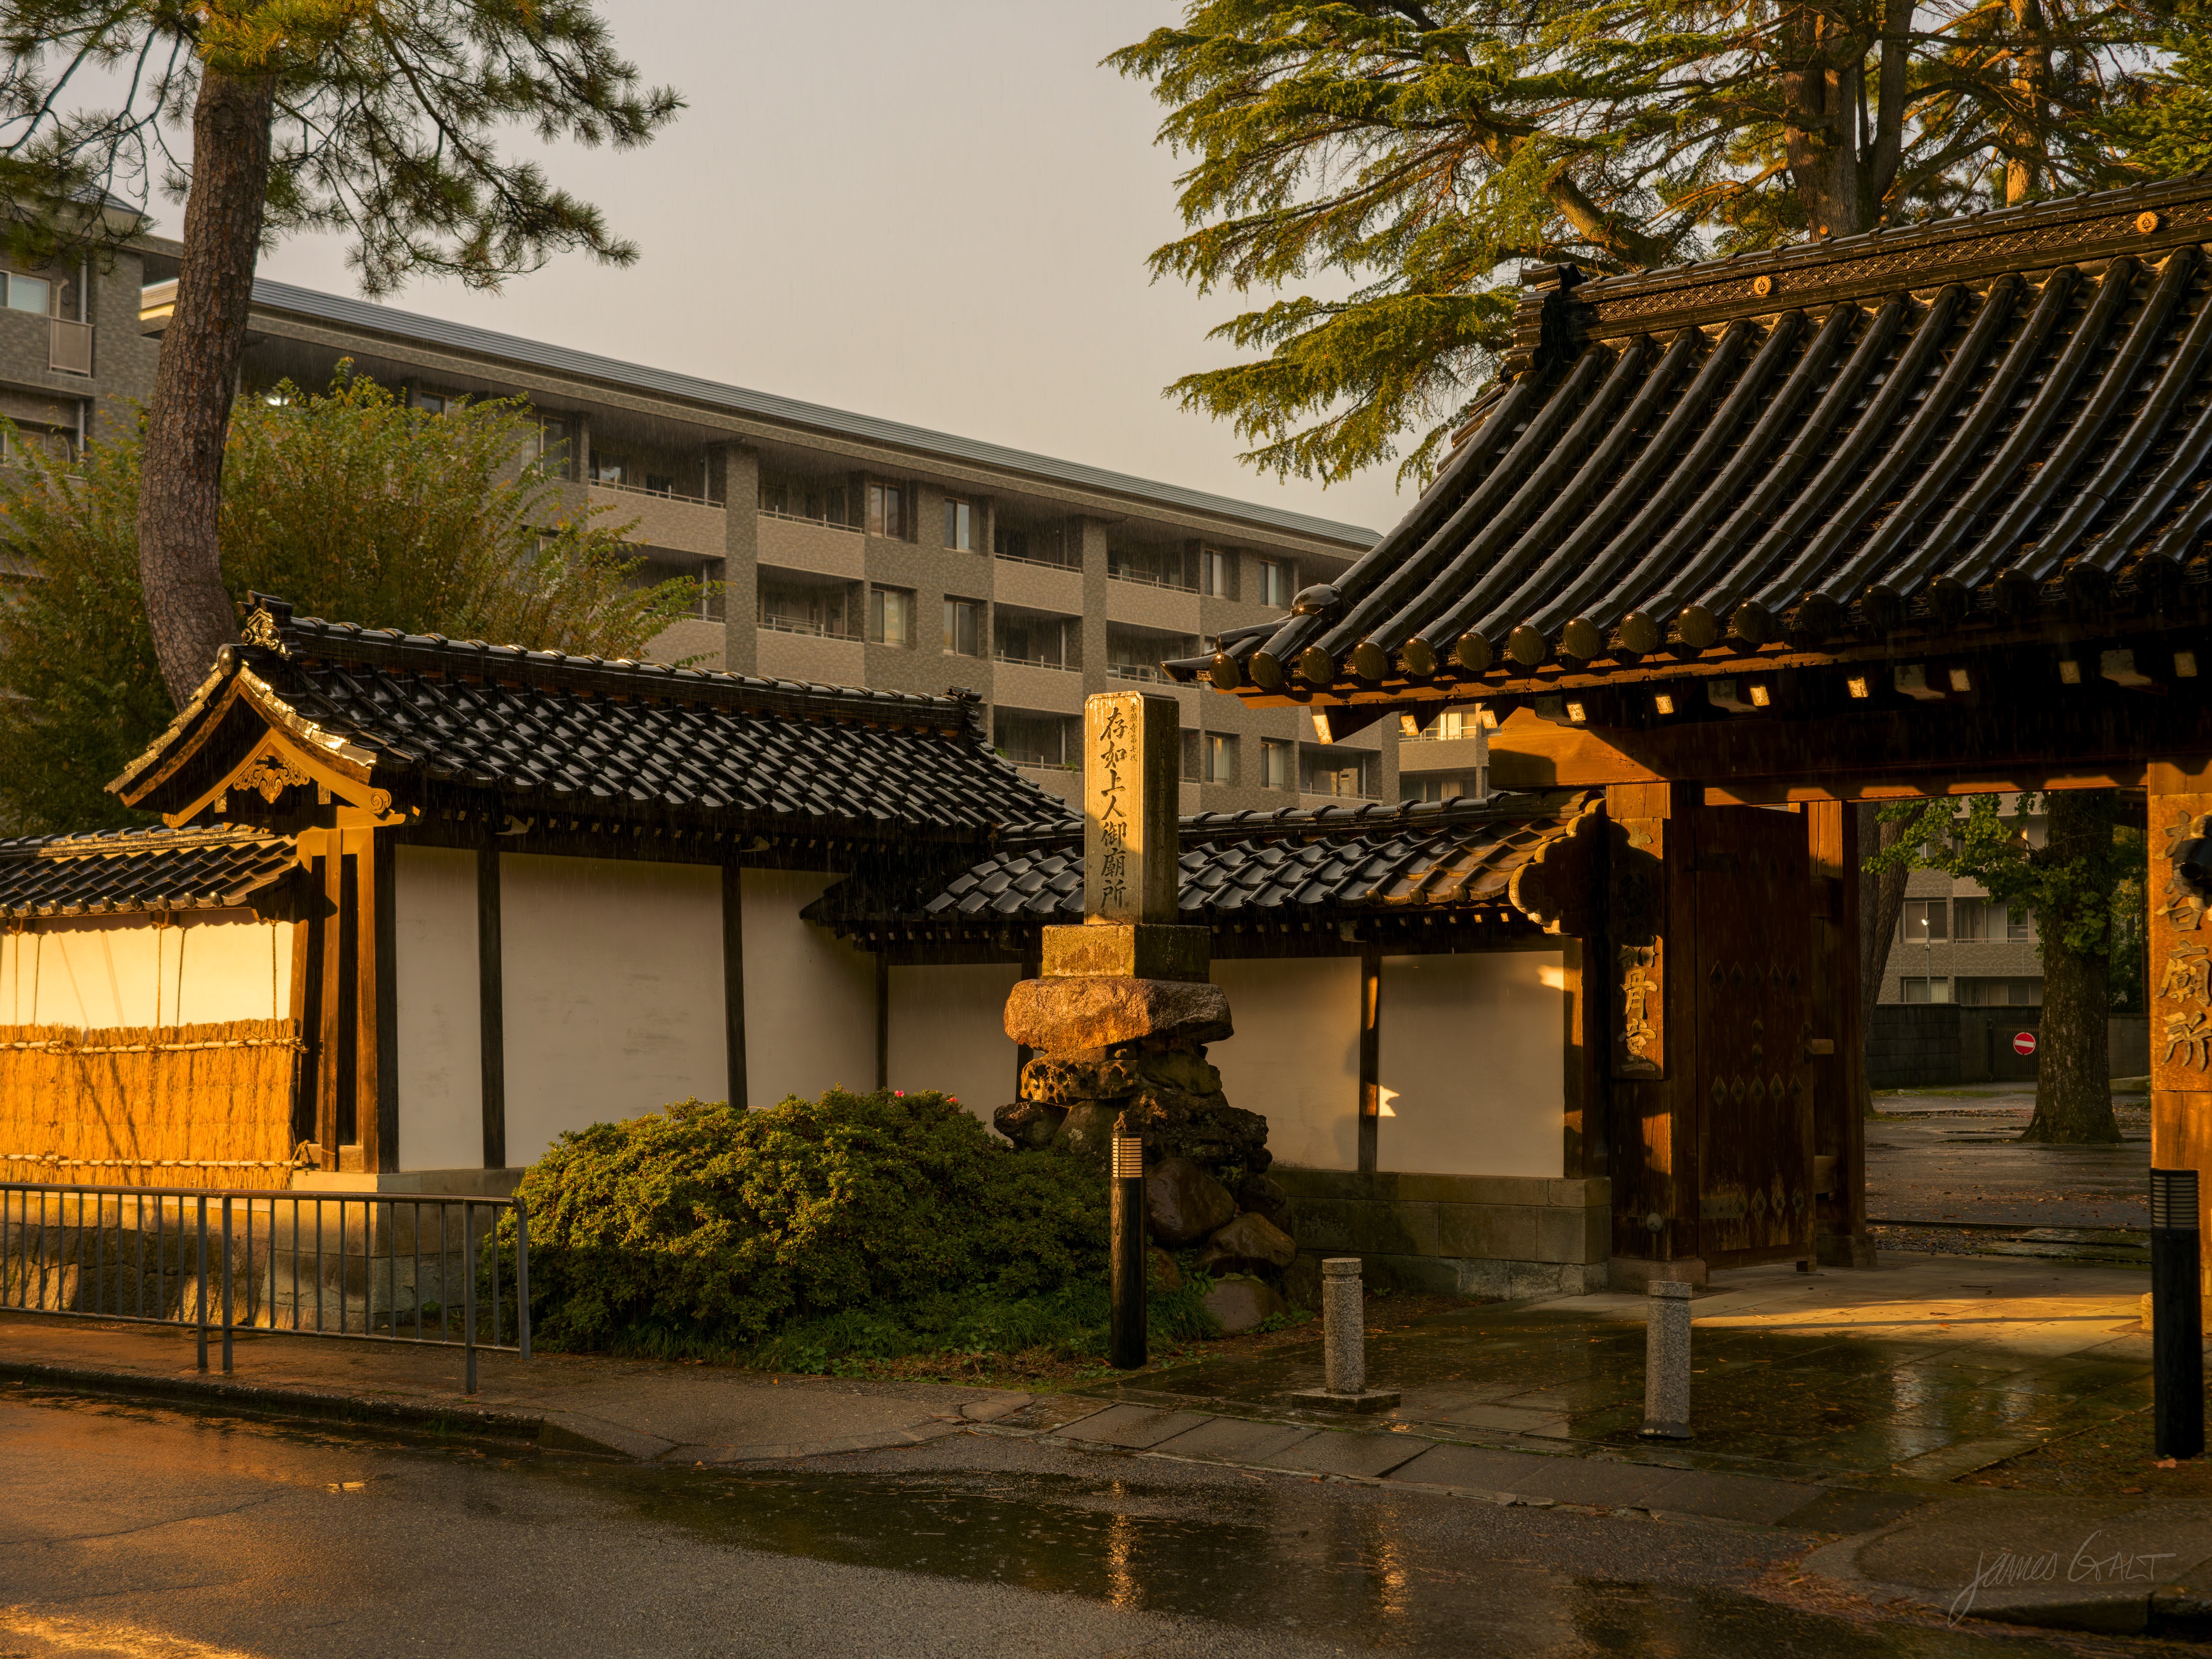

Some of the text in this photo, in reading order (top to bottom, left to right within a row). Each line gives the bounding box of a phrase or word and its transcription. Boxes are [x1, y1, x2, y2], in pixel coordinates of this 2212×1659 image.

[1100, 707, 1128, 909] 存如上人御廟所
